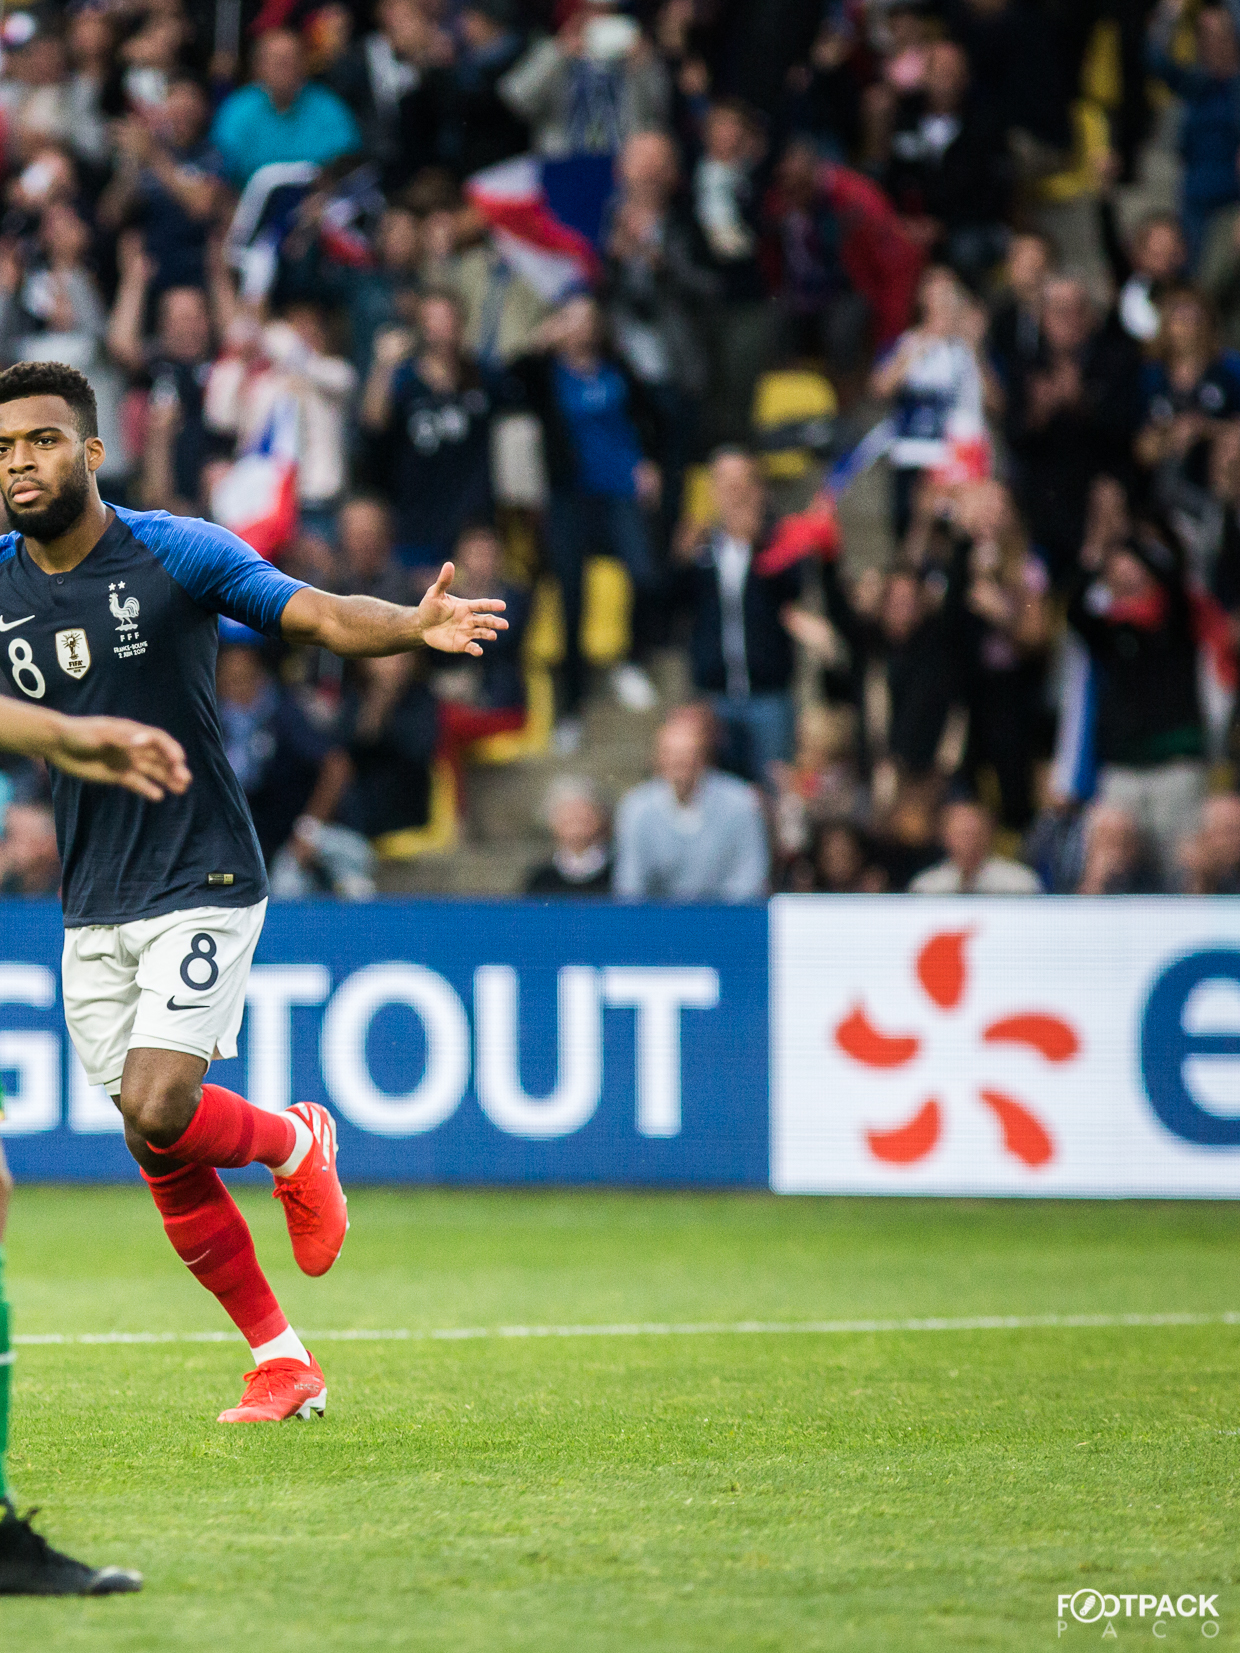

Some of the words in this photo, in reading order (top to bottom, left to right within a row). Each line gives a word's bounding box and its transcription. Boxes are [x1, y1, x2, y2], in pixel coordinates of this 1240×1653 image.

[8, 638, 46, 699] 8
[180, 932, 219, 992] 8
[243, 960, 720, 1140] TOUT
